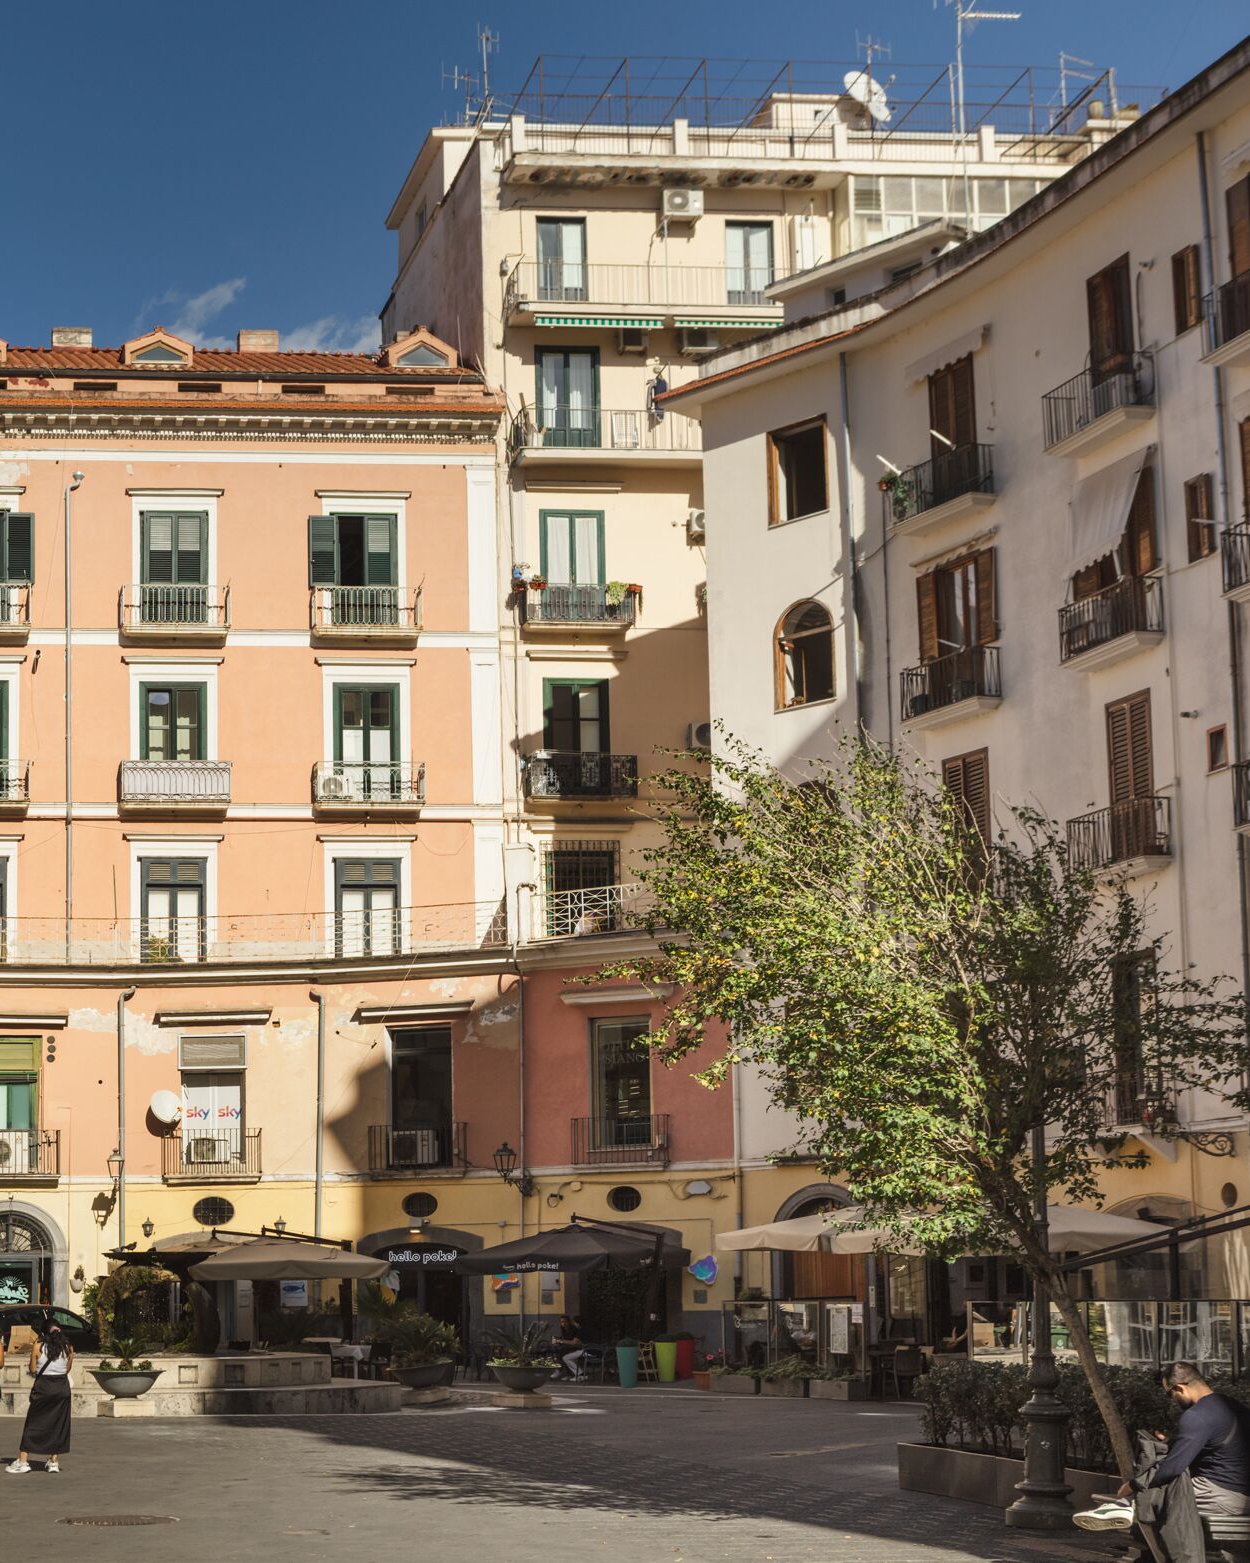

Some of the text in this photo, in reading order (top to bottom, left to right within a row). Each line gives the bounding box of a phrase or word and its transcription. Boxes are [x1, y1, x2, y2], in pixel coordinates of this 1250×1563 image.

[186, 1106, 210, 1120] sky
[218, 1105, 243, 1120] sky
[389, 1250, 421, 1262] hello
[517, 1261, 536, 1270] hello
[537, 1261, 559, 1270] poke!
